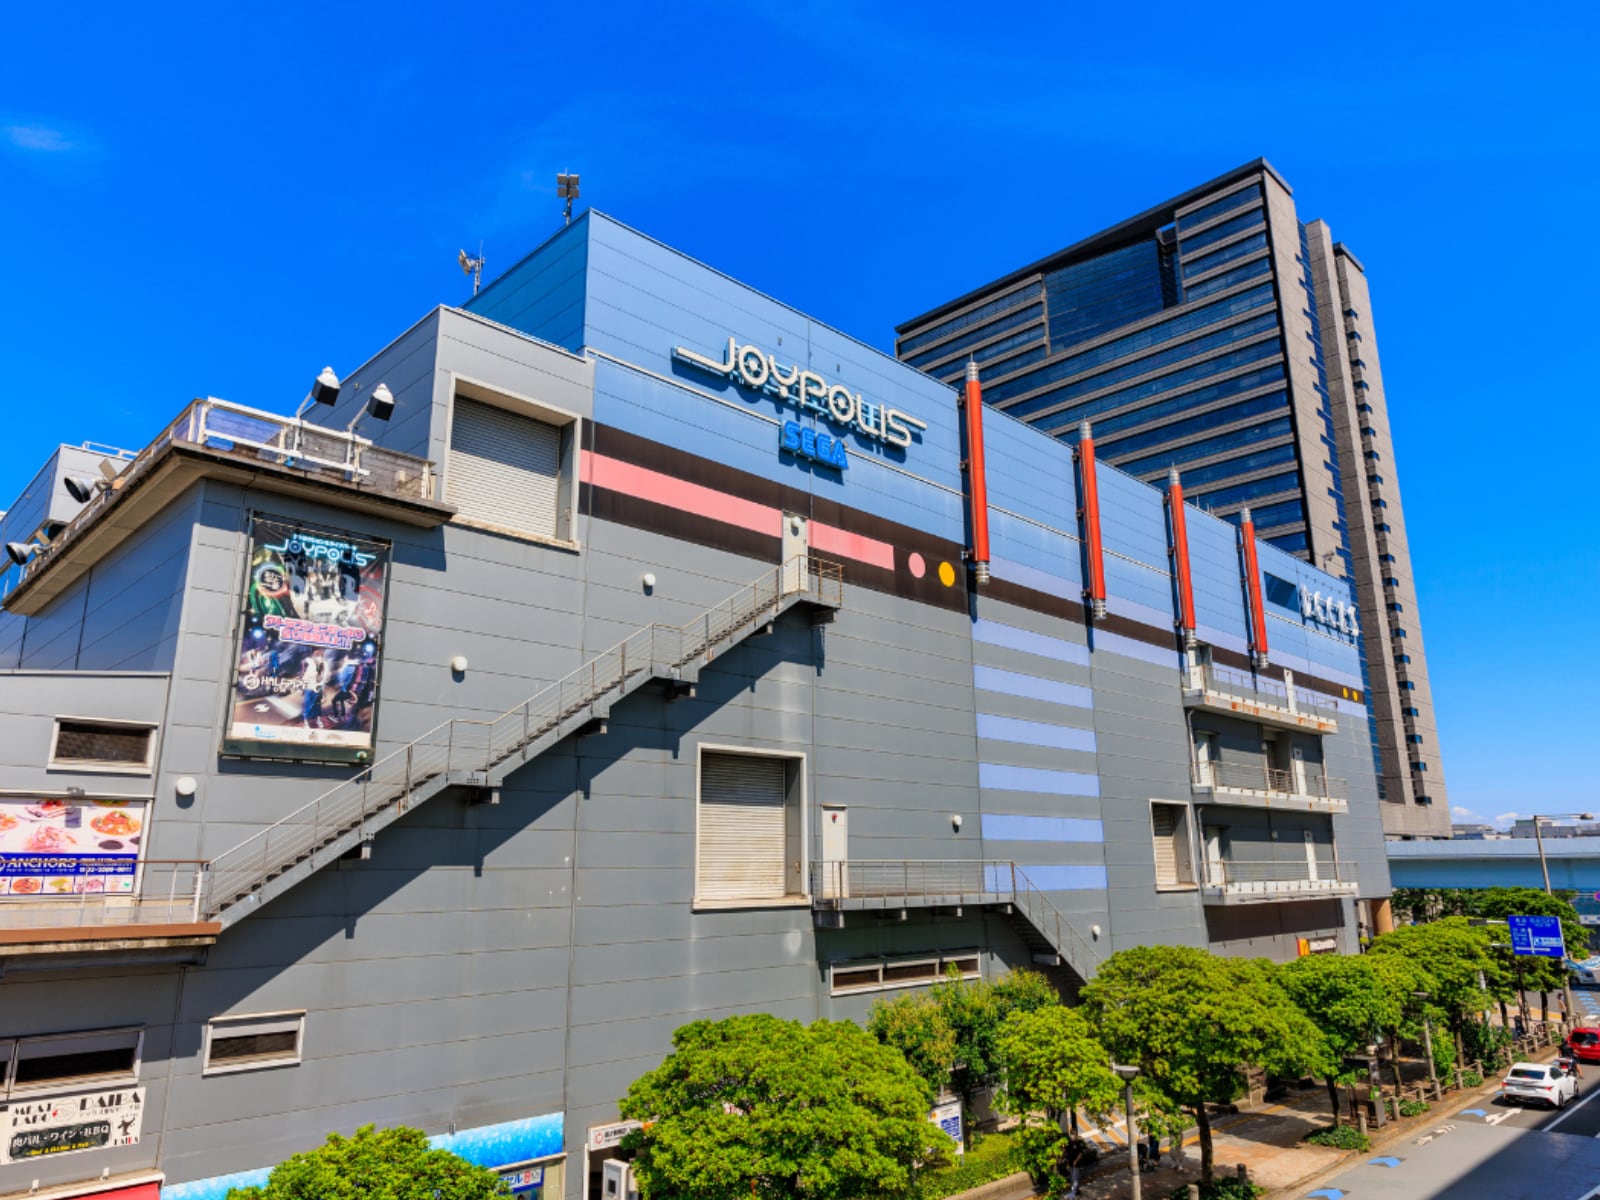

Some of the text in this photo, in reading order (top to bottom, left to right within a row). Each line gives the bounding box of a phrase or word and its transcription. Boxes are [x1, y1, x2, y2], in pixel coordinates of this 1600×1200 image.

[676, 336, 928, 448] JOYPOLIS
[782, 419, 849, 470] SEGA
[263, 538, 377, 567] JOYPOLIS
[7, 857, 77, 869] ANCHORS
